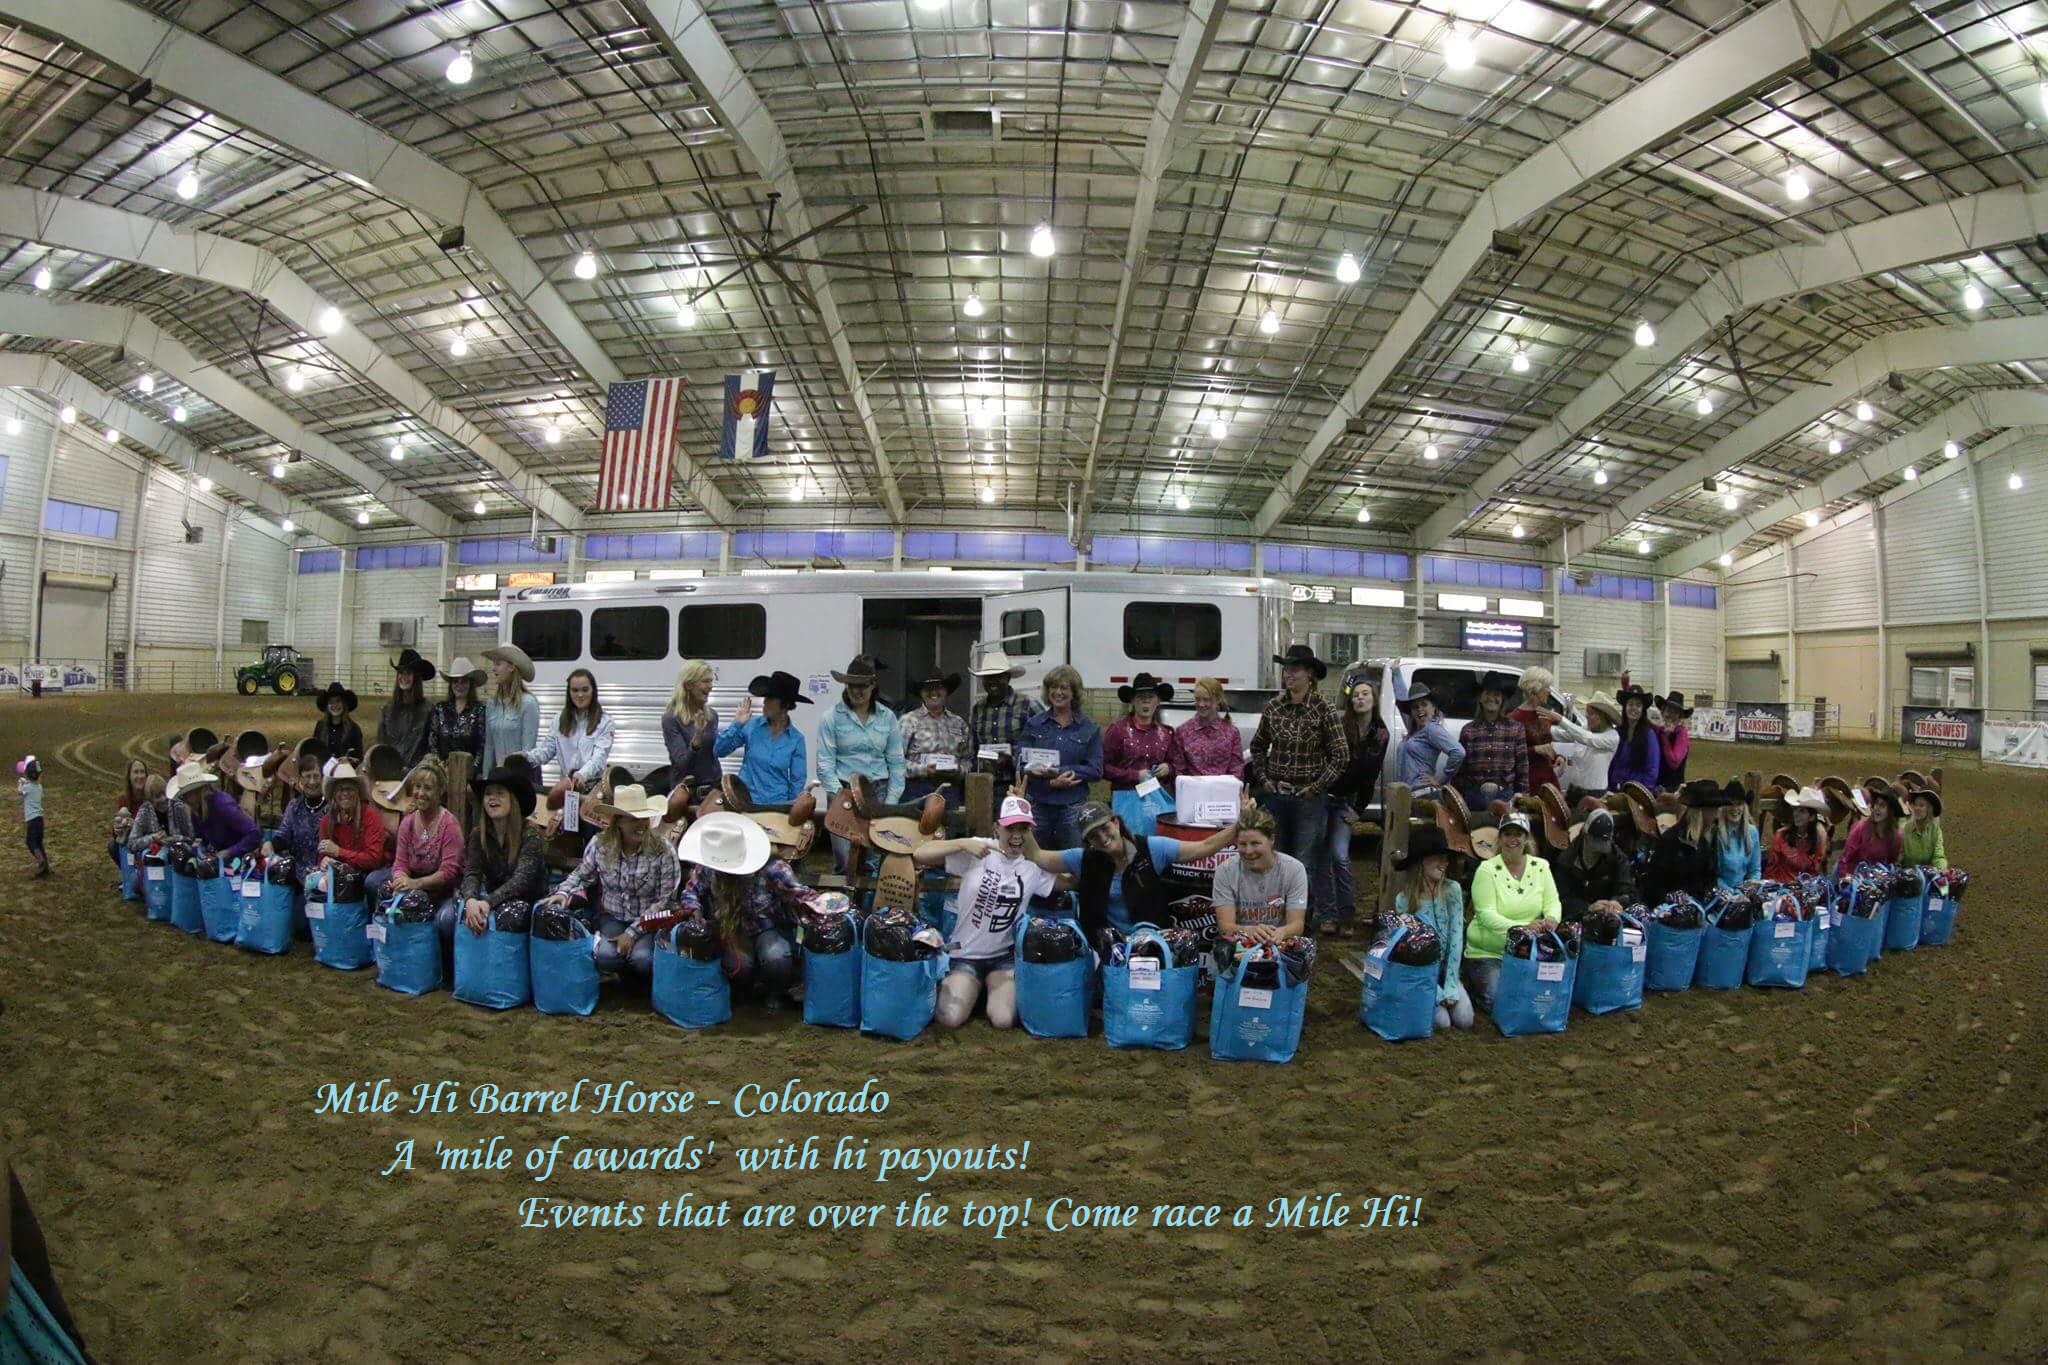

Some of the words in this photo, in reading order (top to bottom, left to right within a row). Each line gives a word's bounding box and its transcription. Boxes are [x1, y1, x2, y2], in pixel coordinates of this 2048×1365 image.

[1740, 719, 1781, 732] TRANSWEST
[1916, 722, 1966, 738] TRANSWEST
[1172, 868, 1201, 878] TRUCK
[971, 869, 995, 929] ALAMOSA
